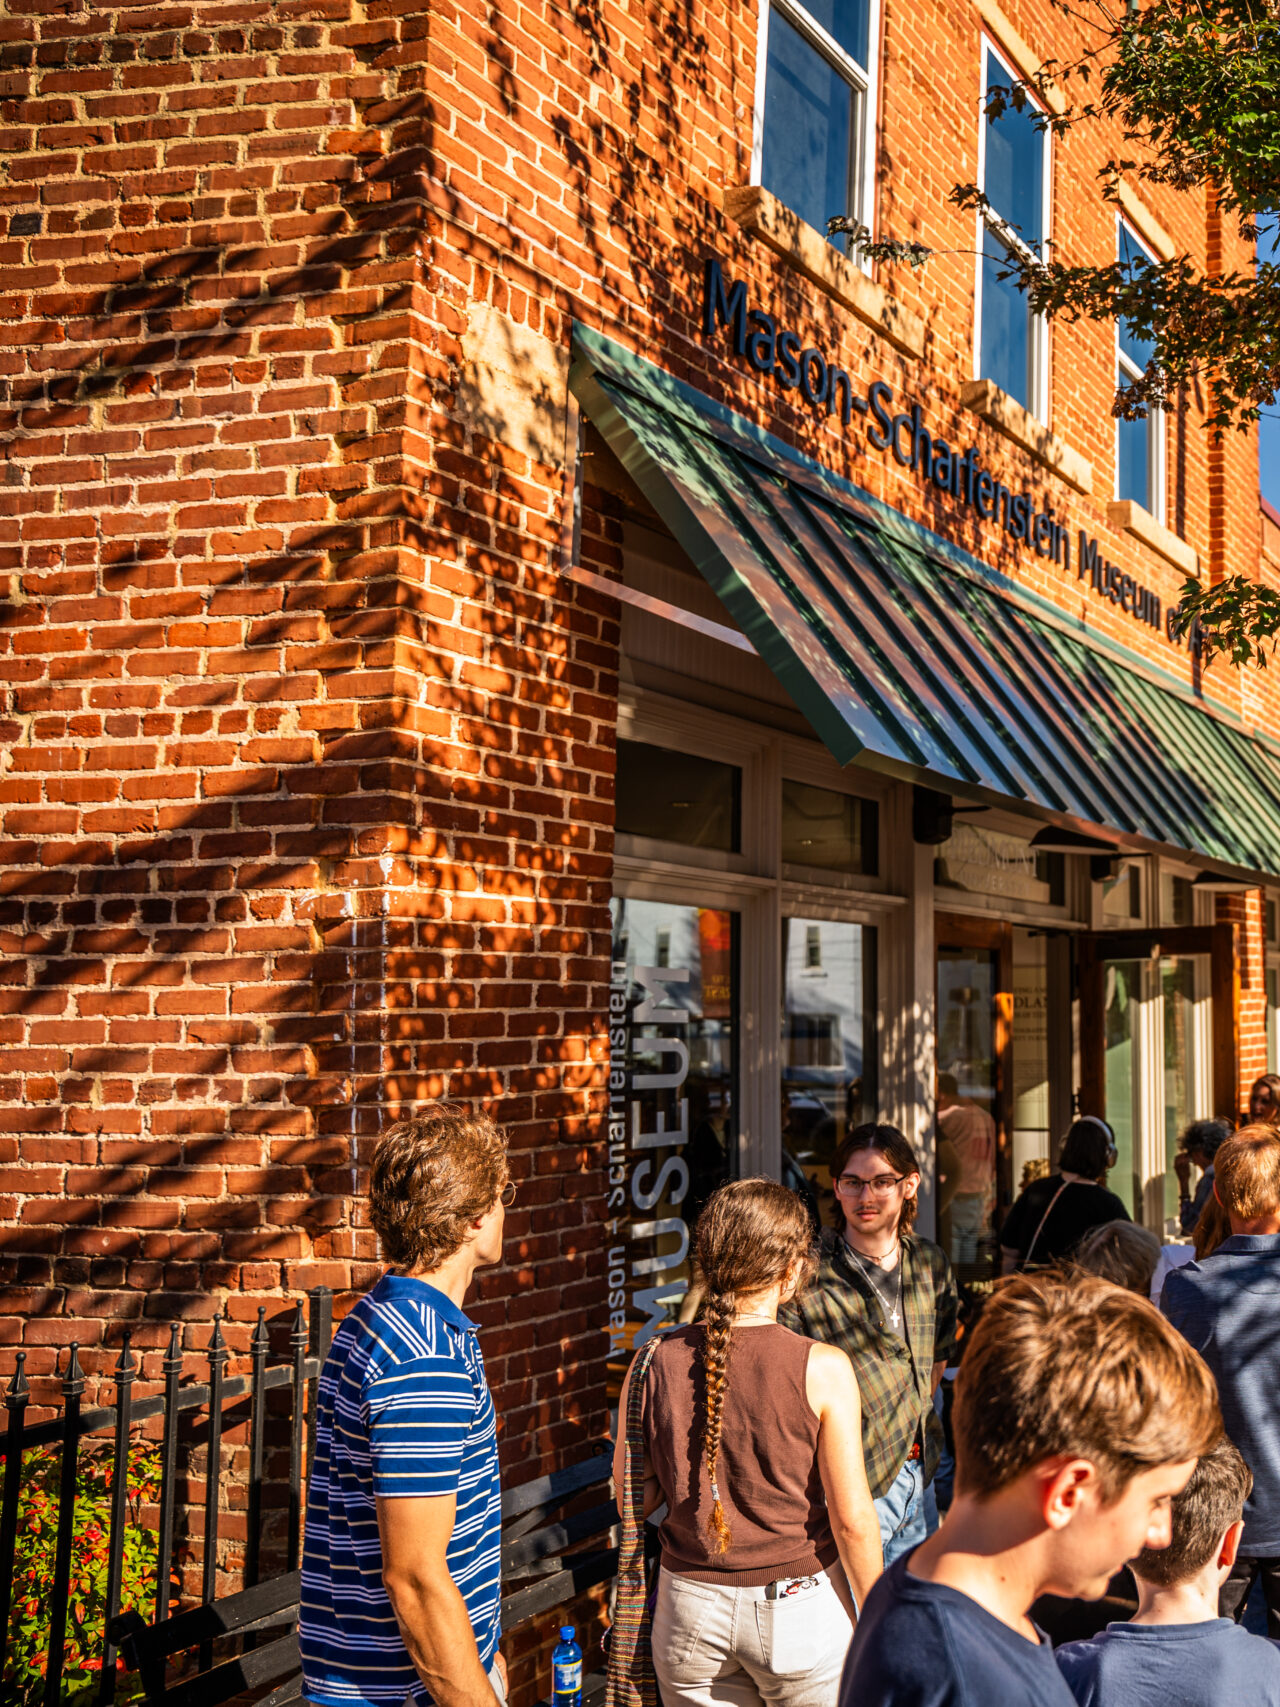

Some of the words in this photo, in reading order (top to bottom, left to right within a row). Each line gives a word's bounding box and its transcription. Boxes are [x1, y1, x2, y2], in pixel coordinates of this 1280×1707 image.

[703, 258, 1071, 571] Mason-Scharfenstein
[1078, 530, 1162, 632] Museum
[631, 965, 691, 1350] MUSEUM
